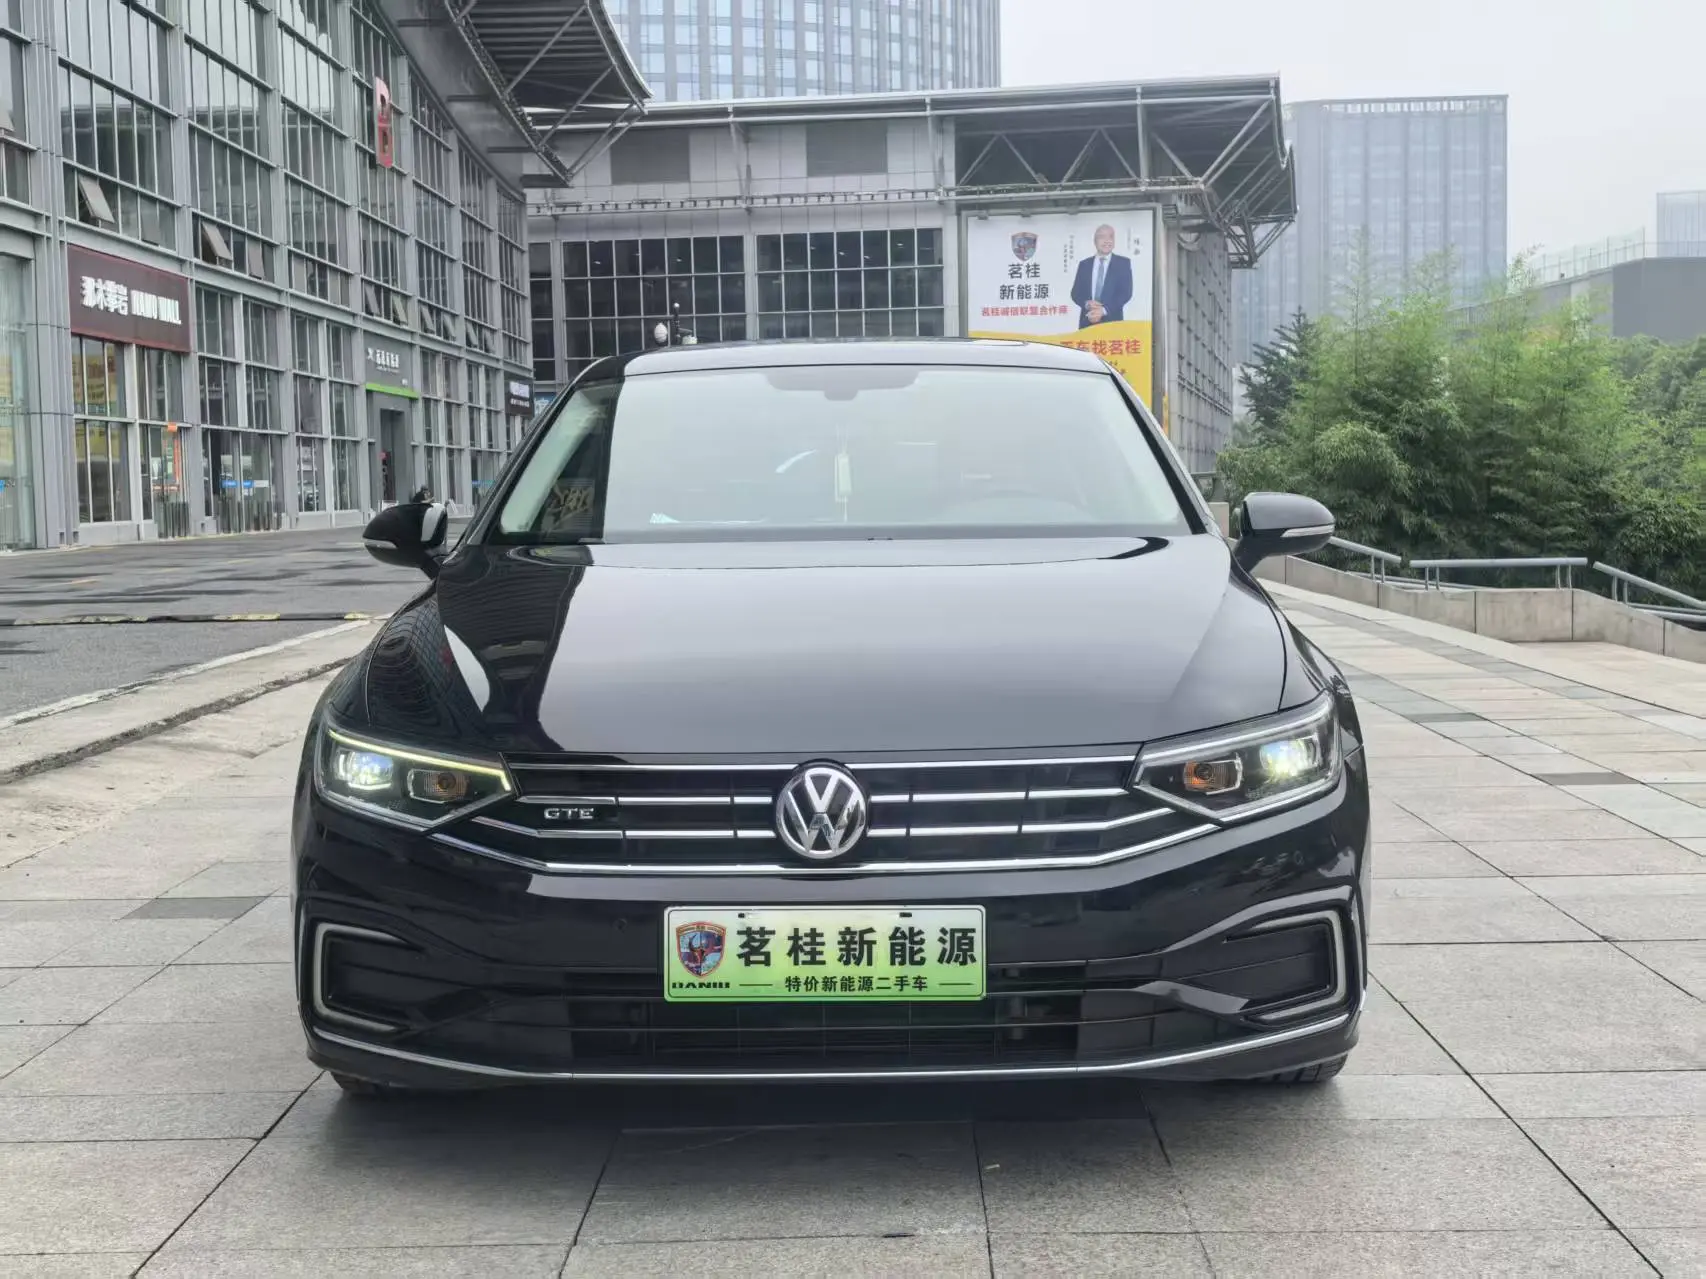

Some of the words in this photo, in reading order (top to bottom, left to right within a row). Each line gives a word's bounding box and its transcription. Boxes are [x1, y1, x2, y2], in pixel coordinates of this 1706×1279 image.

[1008, 263, 1041, 279] 茗桂
[999, 284, 1050, 300] 新能源
[544, 807, 594, 820] GTE
[736, 926, 977, 967] 茗桂新能源
[785, 976, 928, 992] 特价新能源二手车
